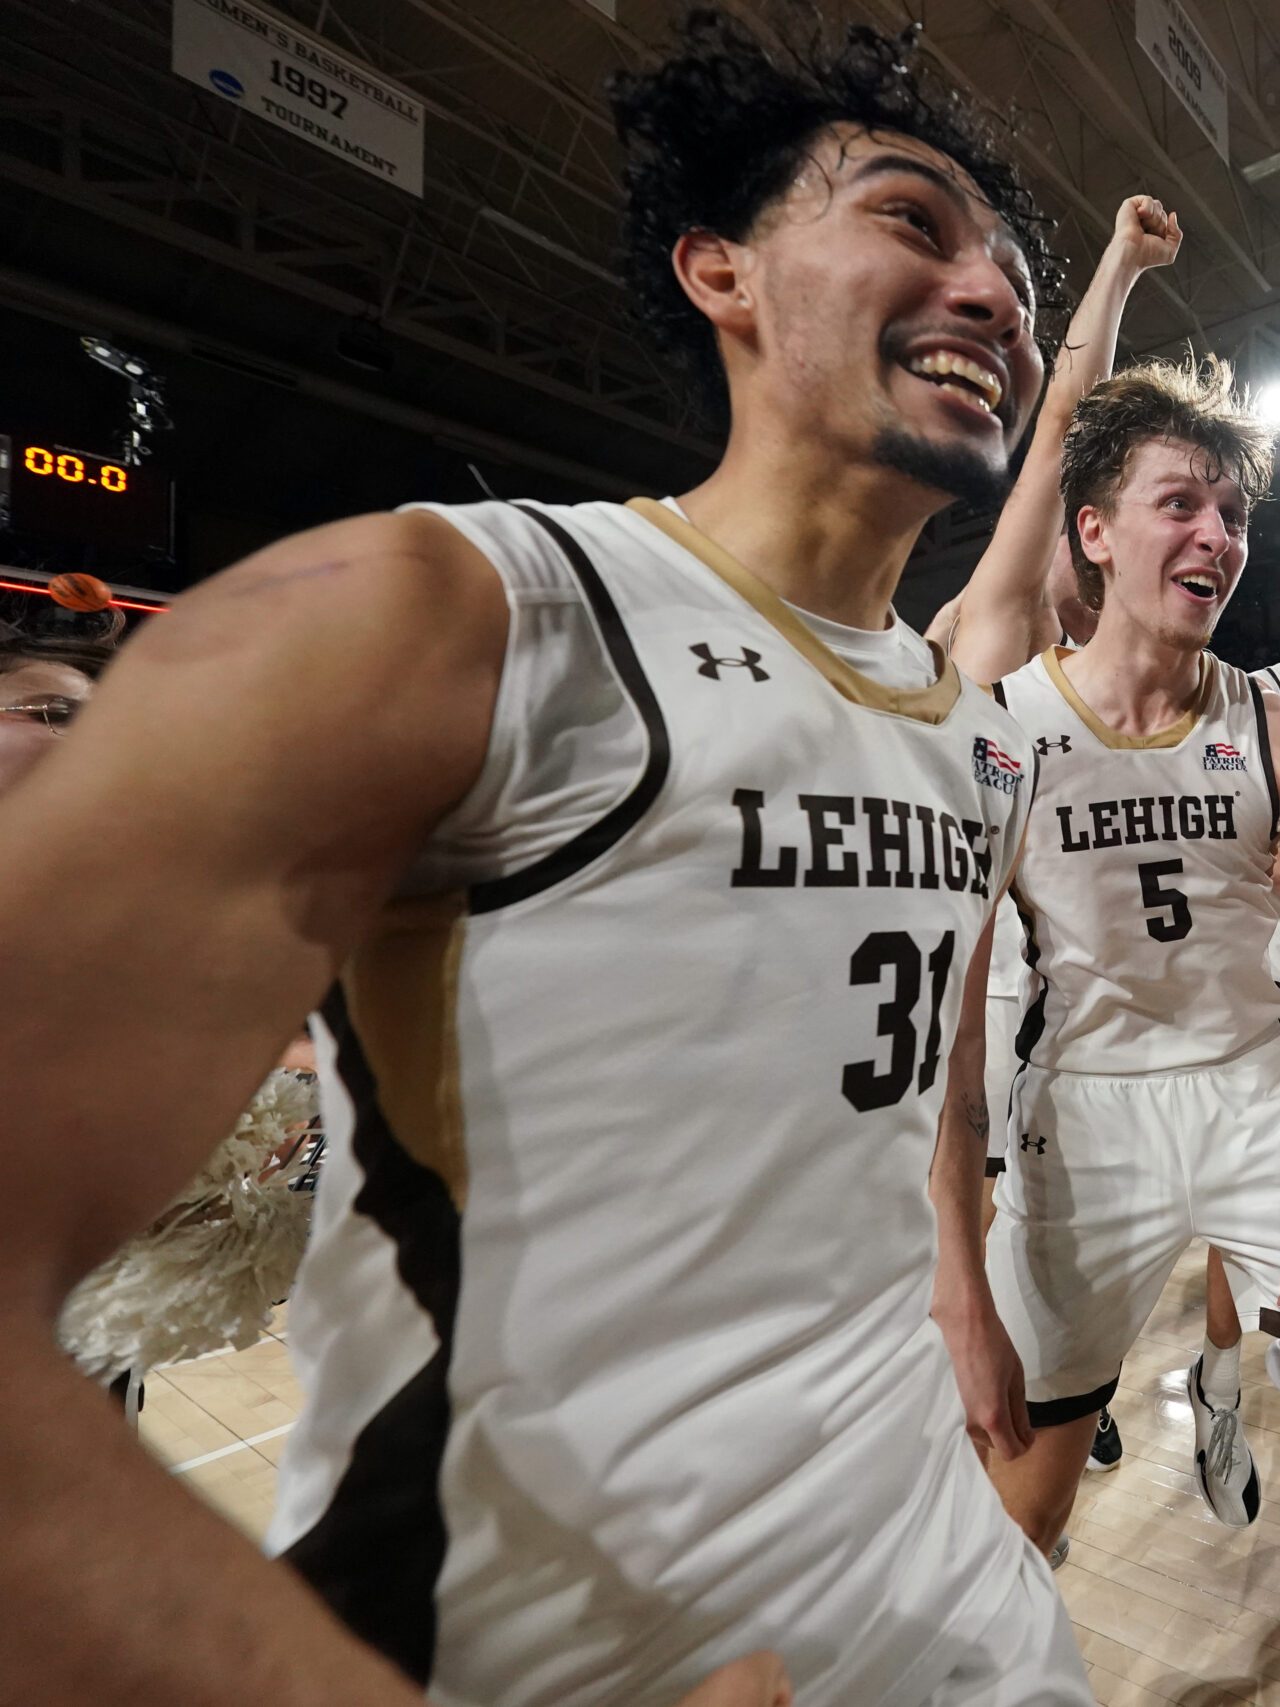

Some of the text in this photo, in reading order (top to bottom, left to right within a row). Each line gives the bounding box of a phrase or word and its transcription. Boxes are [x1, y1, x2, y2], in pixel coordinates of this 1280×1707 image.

[270, 59, 348, 120] 1997
[295, 43, 418, 122] BASKETBALL
[261, 96, 397, 176] TOURNAMENT
[25, 447, 126, 492] 00.0
[731, 788, 988, 899] LEHIGH
[1056, 795, 1237, 853] LEHIGH
[1138, 858, 1192, 942] 5
[841, 931, 955, 1113] 31
